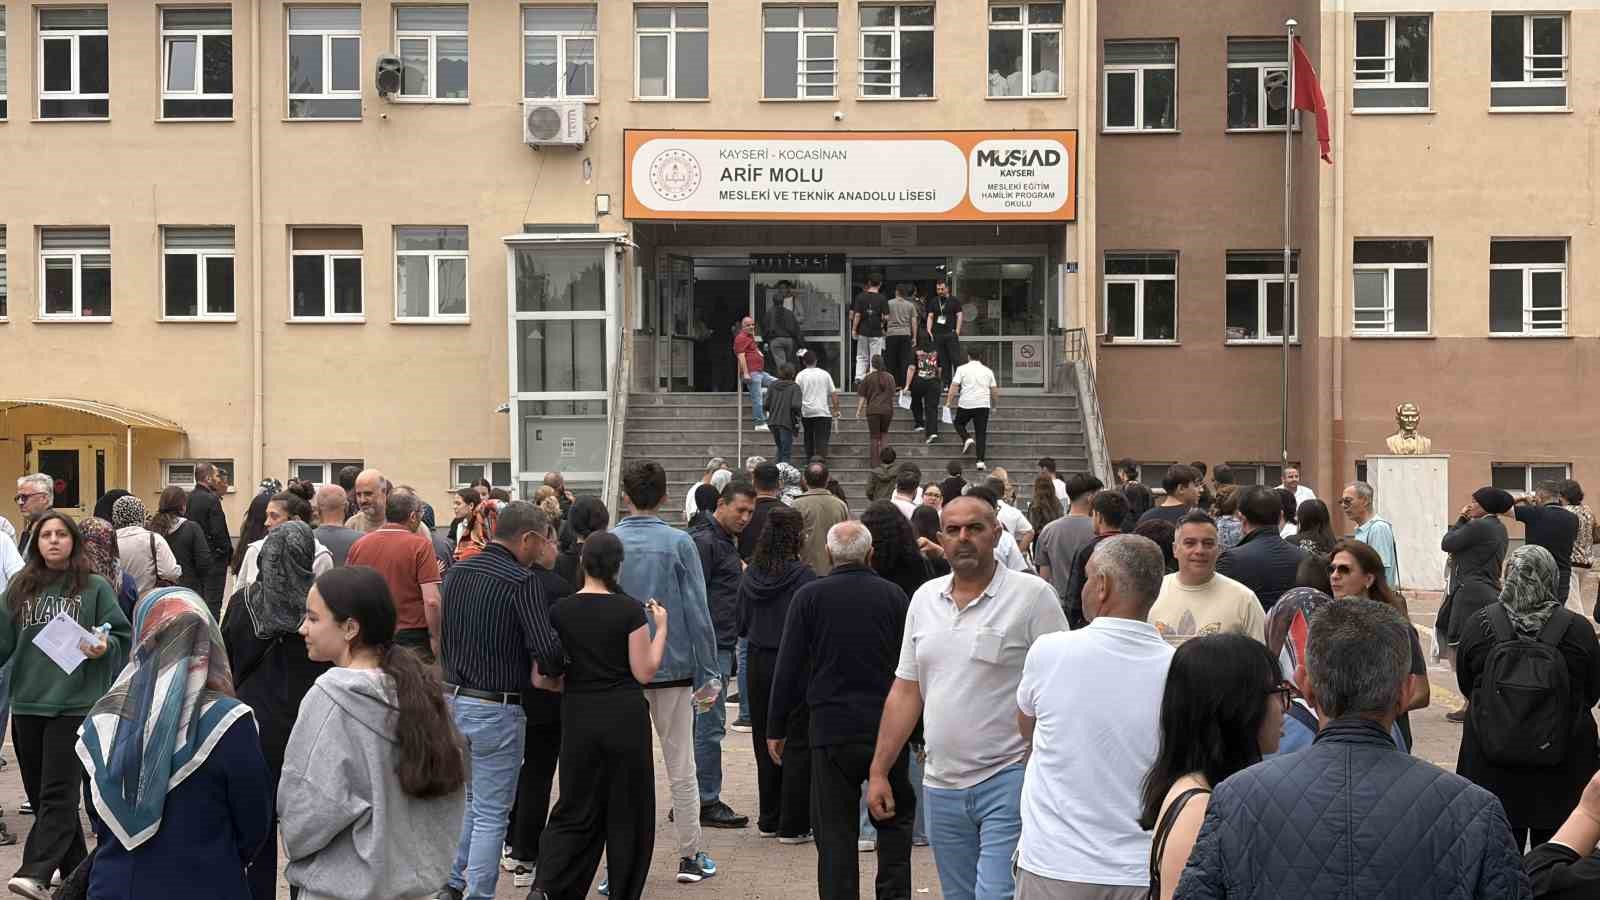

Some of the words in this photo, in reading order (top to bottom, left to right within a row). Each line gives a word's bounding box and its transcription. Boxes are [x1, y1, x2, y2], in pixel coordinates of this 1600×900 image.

[719, 147, 769, 161] KAYSERİ
[778, 147, 848, 161] KOCASİNAN
[720, 163, 764, 183] ARİF
[769, 167, 824, 183] MOLU
[1000, 168, 1035, 177] KAYSERİ
[987, 182, 1022, 191] MESLEKİ
[1023, 181, 1050, 191] EĞİTİM
[719, 188, 770, 201] MESLEKİ
[773, 190, 789, 201] VE
[792, 188, 835, 201] TEKNİK
[837, 190, 896, 201] ANADOLU
[899, 188, 937, 201] LİSESİ
[1004, 200, 1032, 208] OKULU
